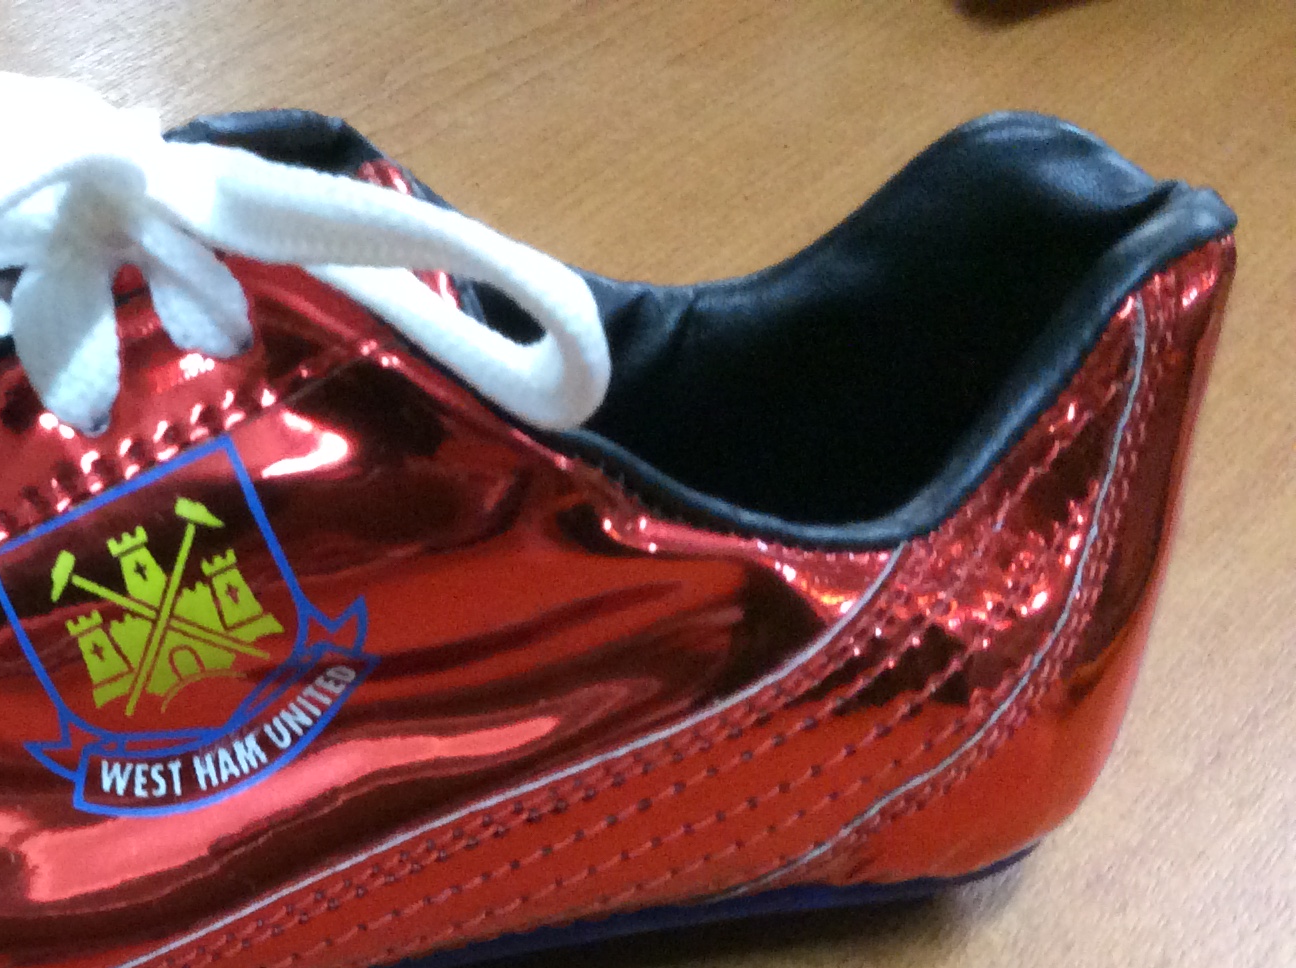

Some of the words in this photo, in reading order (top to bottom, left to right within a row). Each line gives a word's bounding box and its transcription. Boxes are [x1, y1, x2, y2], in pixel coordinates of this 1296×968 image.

[100, 759, 182, 797] WEST
[193, 731, 268, 790] HAM
[263, 666, 356, 749] UNITED
